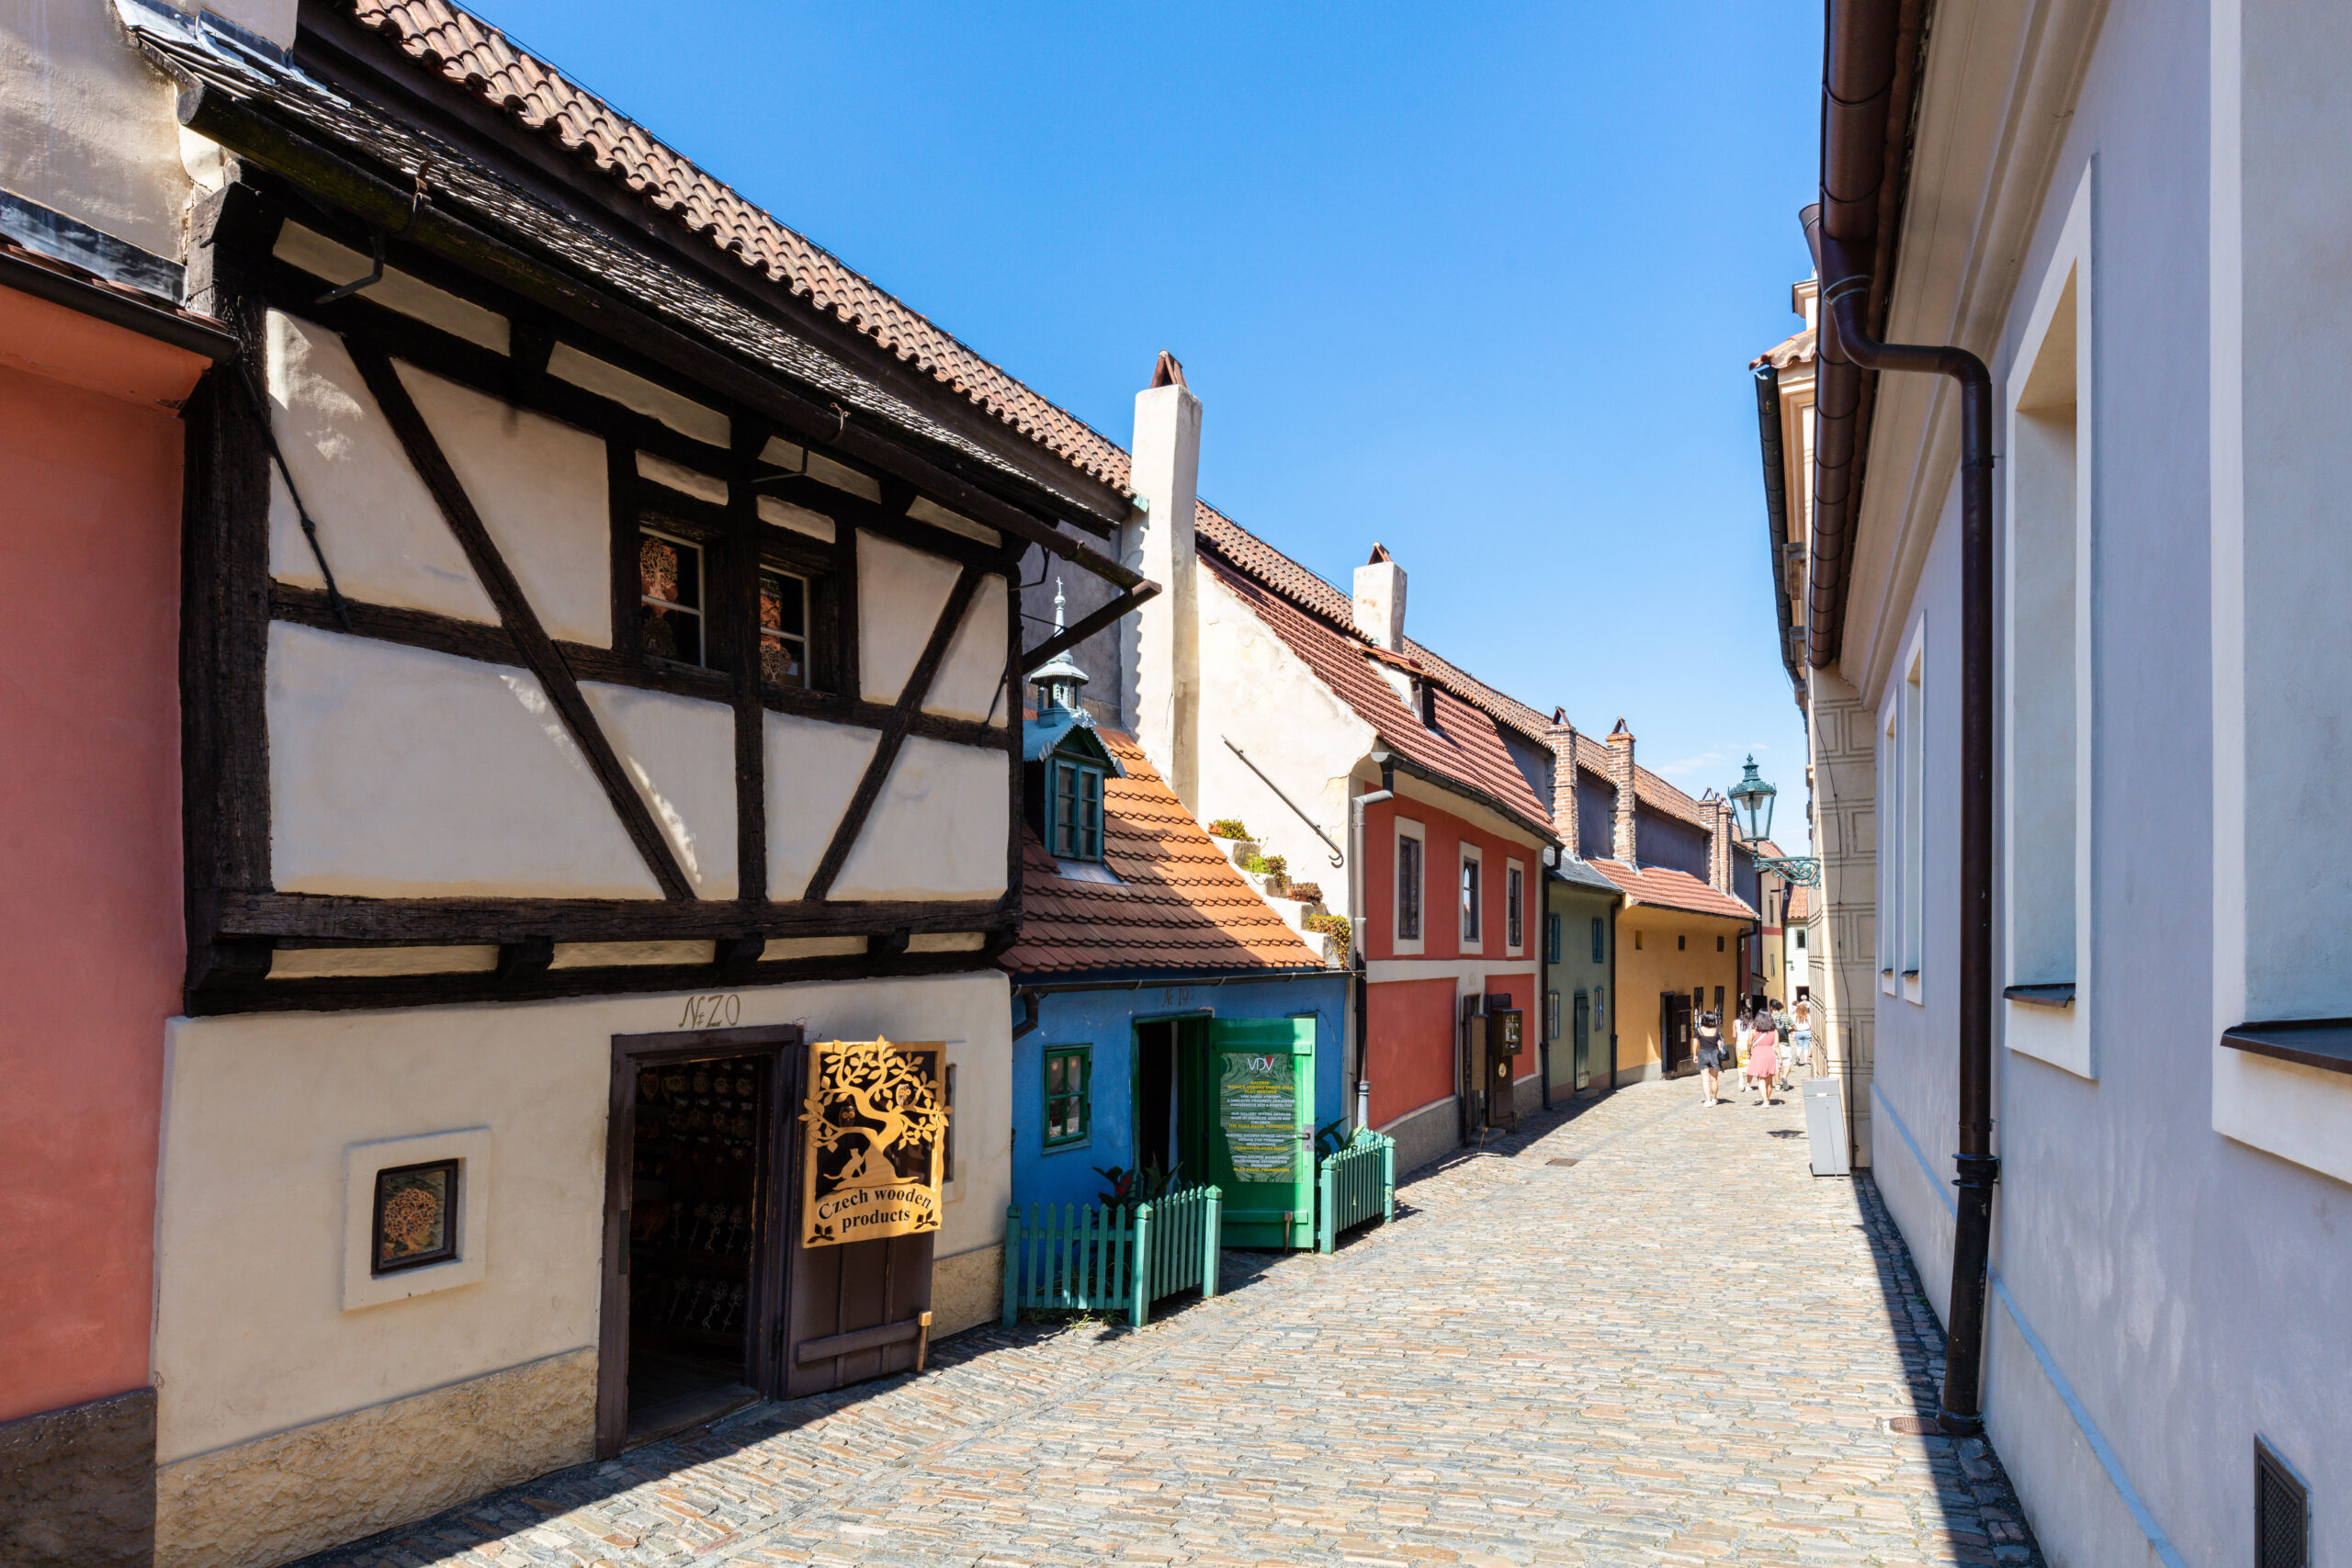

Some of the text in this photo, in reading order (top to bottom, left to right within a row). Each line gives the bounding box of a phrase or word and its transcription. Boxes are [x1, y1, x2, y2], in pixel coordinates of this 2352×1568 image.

[1247, 1056, 1274, 1071] VDV
[818, 1188, 932, 1220] Czech wooden
[842, 1208, 910, 1234] products
